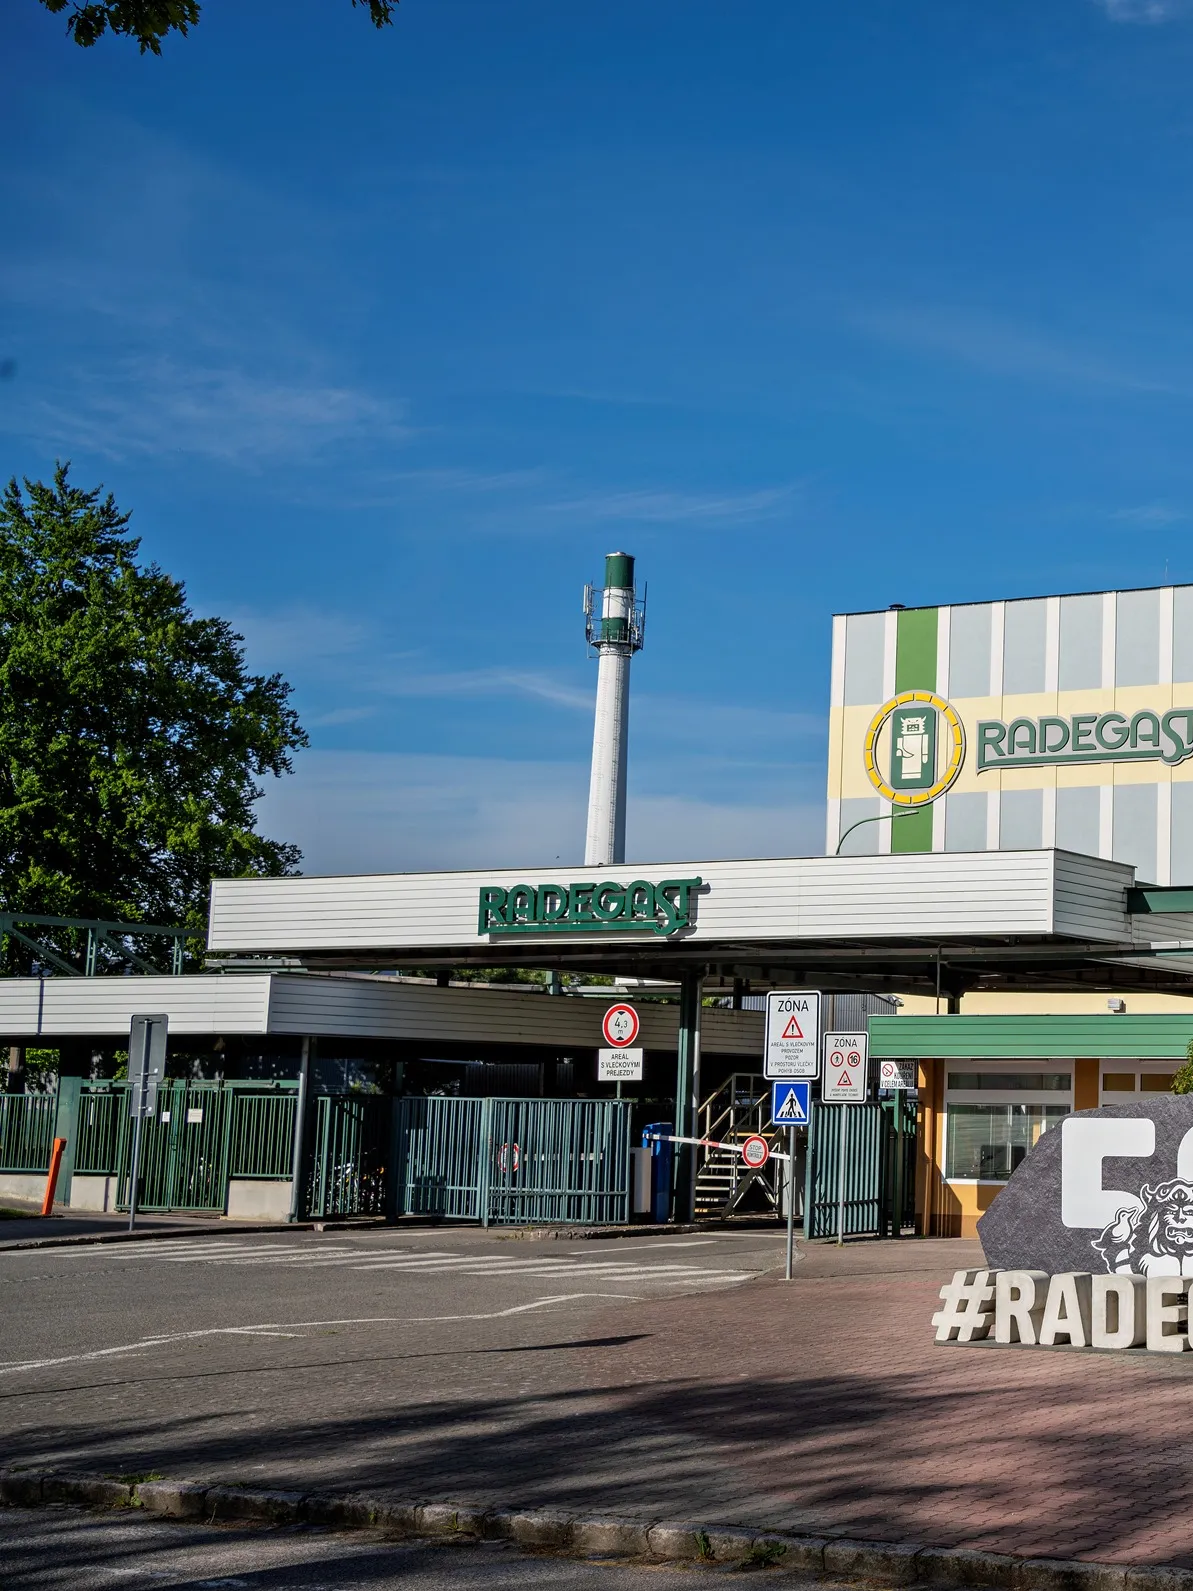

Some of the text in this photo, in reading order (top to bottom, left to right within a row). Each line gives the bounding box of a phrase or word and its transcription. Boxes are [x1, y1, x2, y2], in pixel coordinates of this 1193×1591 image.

[478, 876, 702, 936] RADEGAST
[777, 997, 809, 1012] ZÓNA
[834, 1037, 858, 1048] ZÓNA
